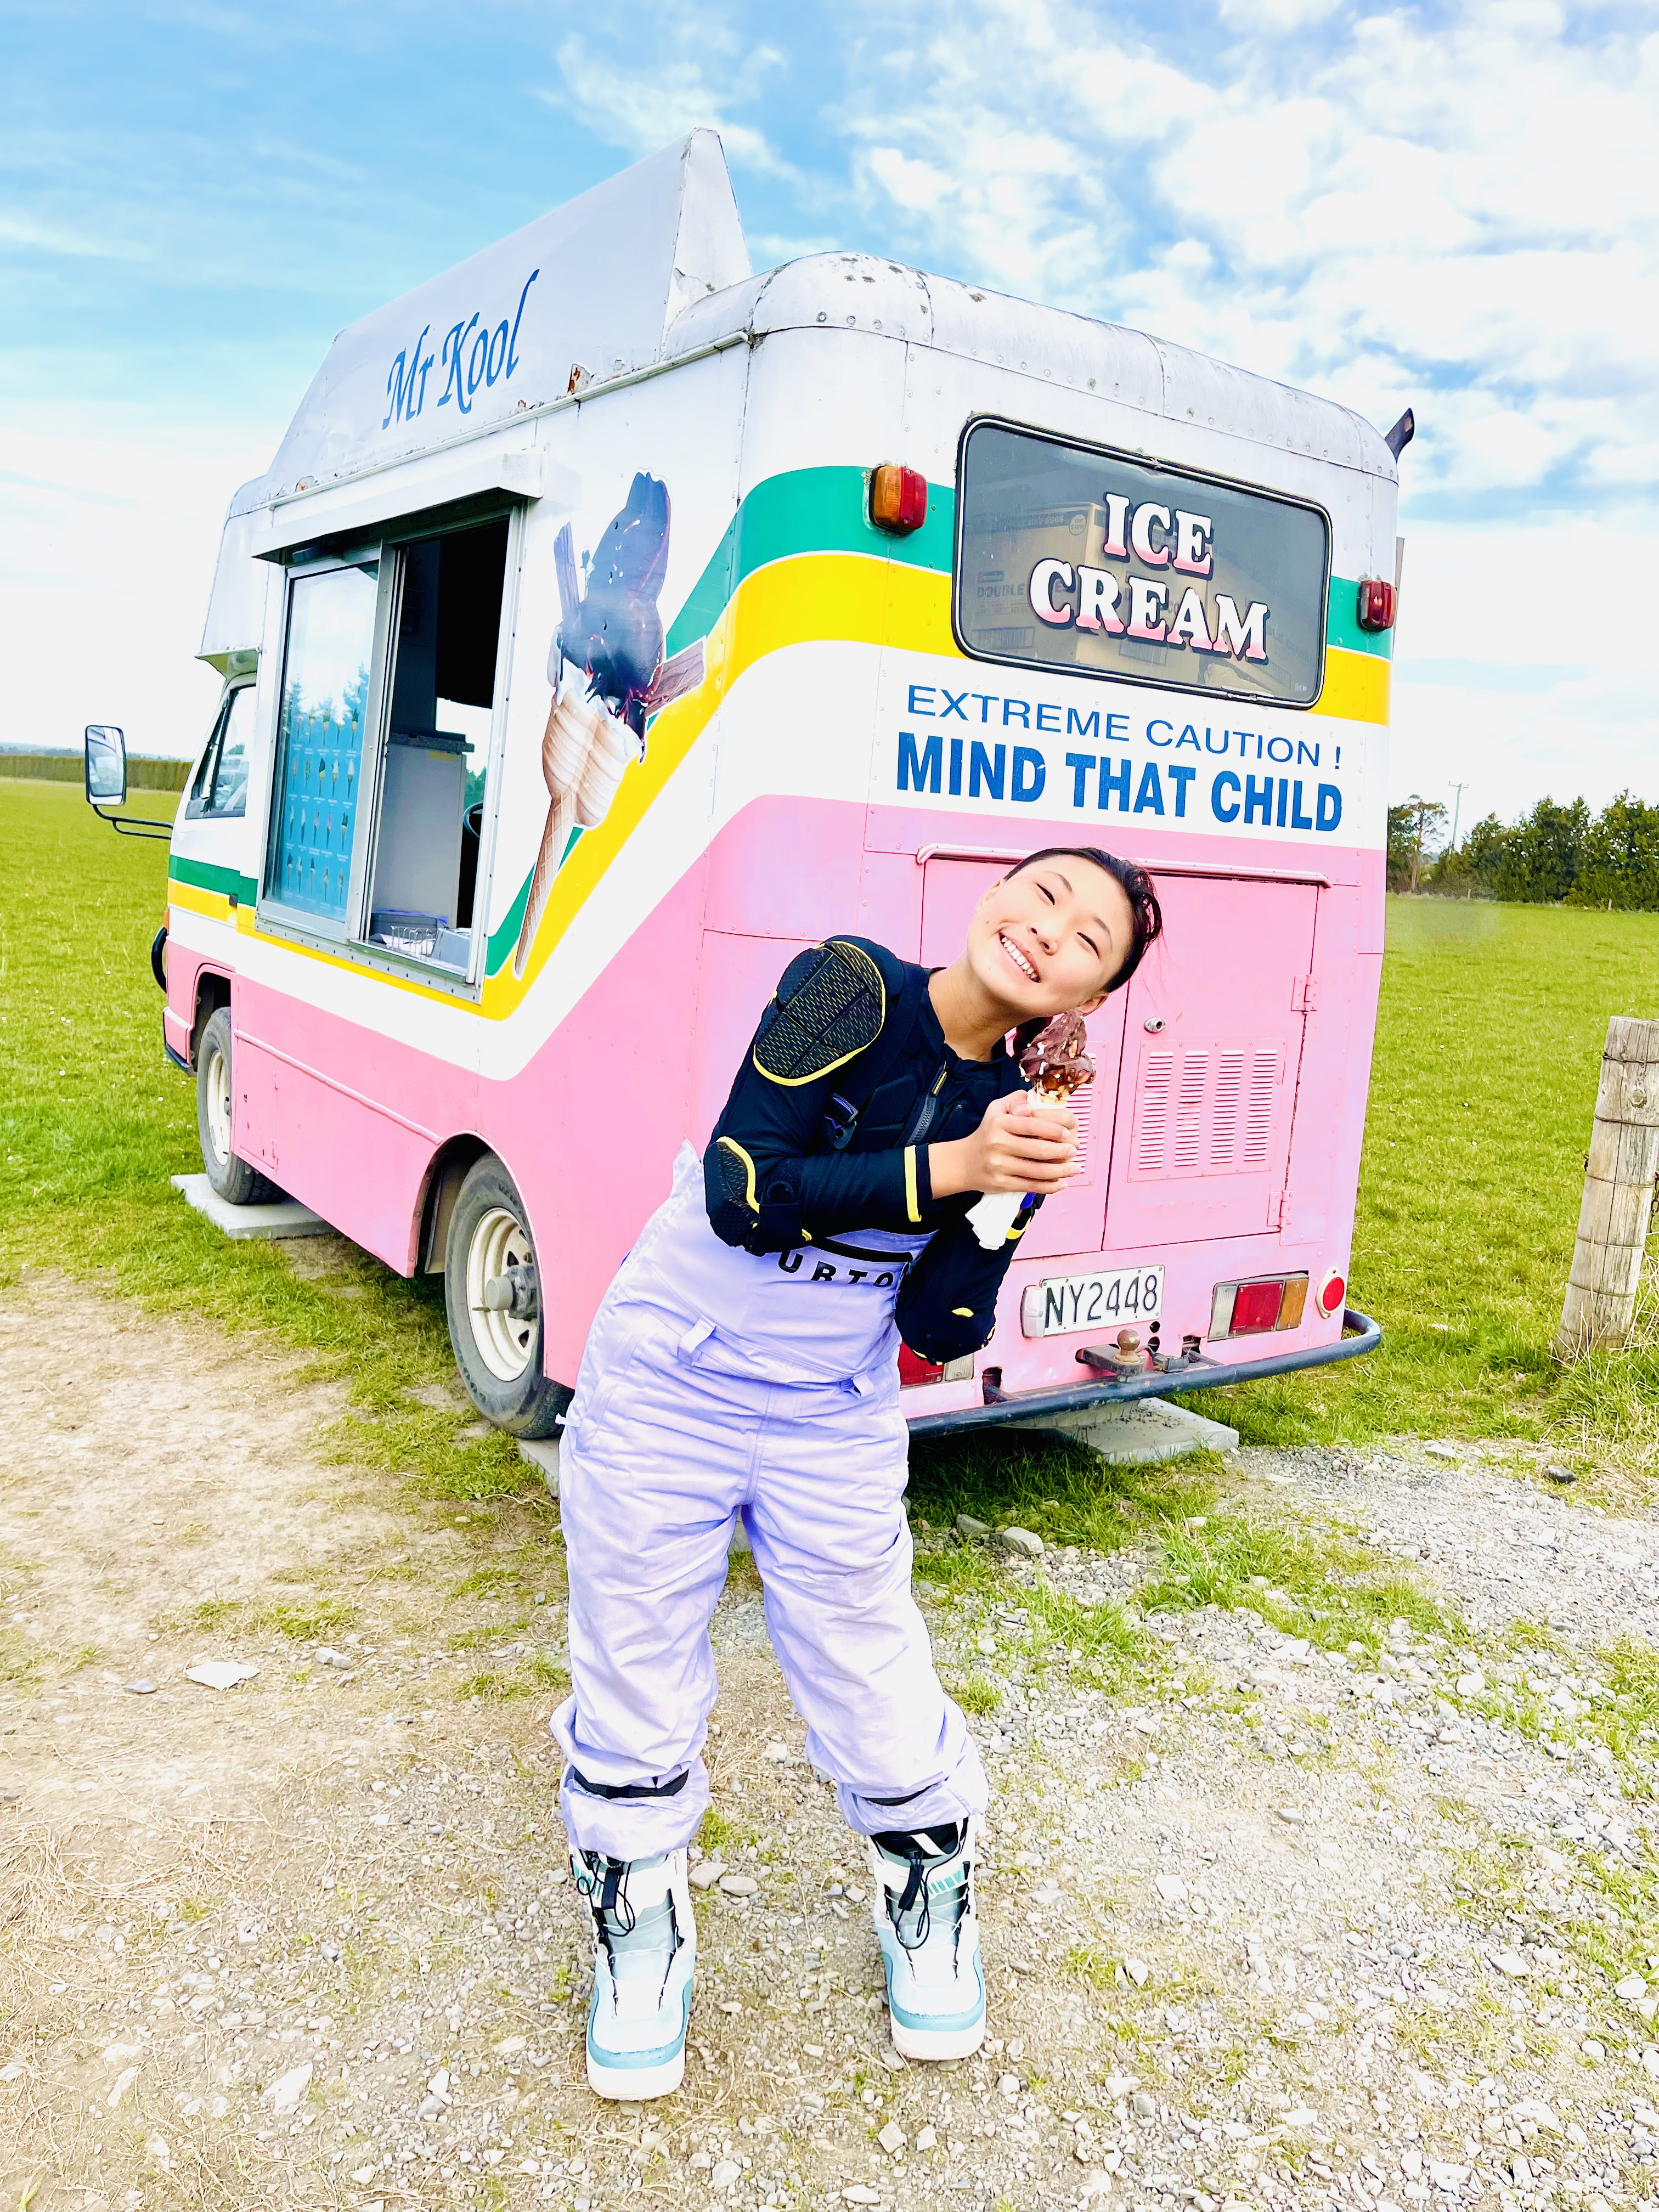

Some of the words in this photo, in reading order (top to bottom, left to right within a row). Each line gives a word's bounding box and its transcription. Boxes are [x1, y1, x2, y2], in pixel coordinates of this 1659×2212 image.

[382, 324, 435, 430] Mr
[437, 312, 540, 415] Kool
[1102, 492, 1214, 579] ICE
[977, 583, 1025, 598] DOUBLE
[1029, 558, 1270, 665] CREAM
[907, 684, 1130, 742] EXTREME
[1146, 720, 1320, 767] CAUTION
[896, 731, 1046, 803] MIND
[1065, 752, 1197, 818] THAT
[1211, 770, 1342, 832] CHILD
[749, 1250, 894, 1288] URTO
[1045, 1274, 1157, 1328] NY2448
